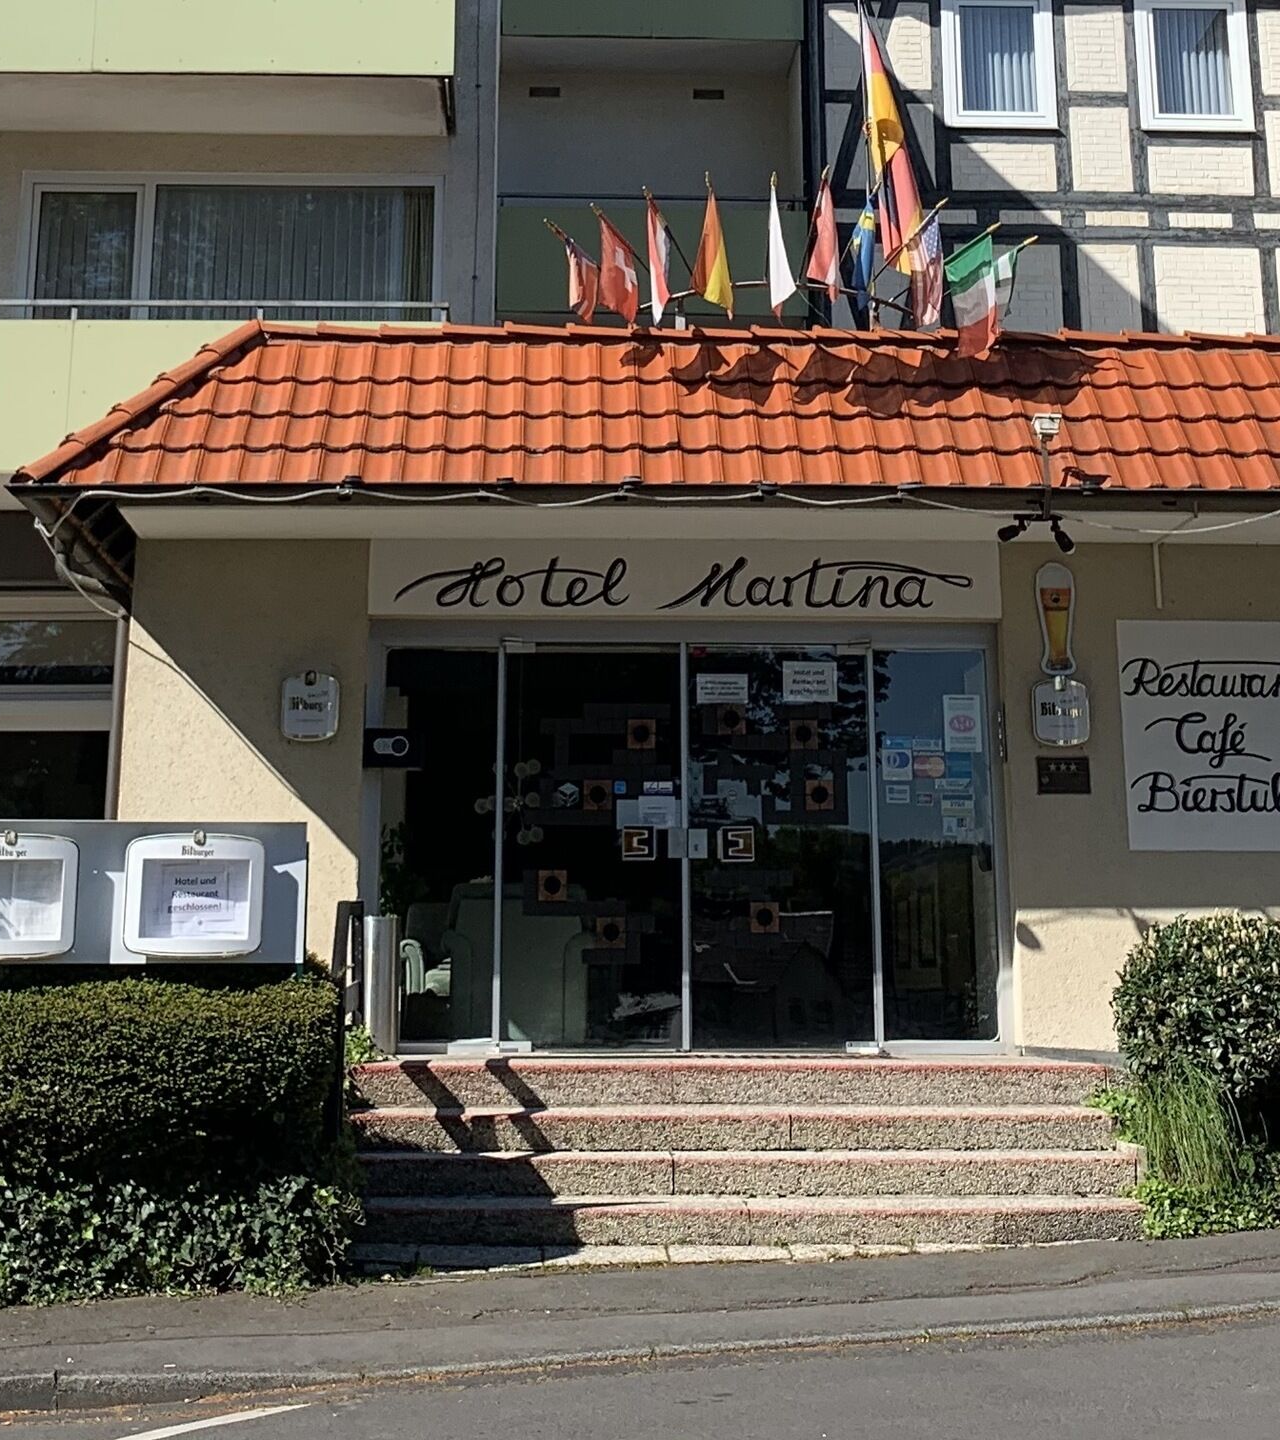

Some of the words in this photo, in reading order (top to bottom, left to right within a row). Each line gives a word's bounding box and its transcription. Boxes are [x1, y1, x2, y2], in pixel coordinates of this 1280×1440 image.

[394, 556, 631, 608] Hotel
[656, 556, 973, 610] Martina
[1145, 712, 1272, 768] Café
[181, 845, 215, 857] Bitburger
[174, 877, 198, 885] Hotel
[200, 876, 216, 885] und
[167, 902, 222, 914] geschlossen!
